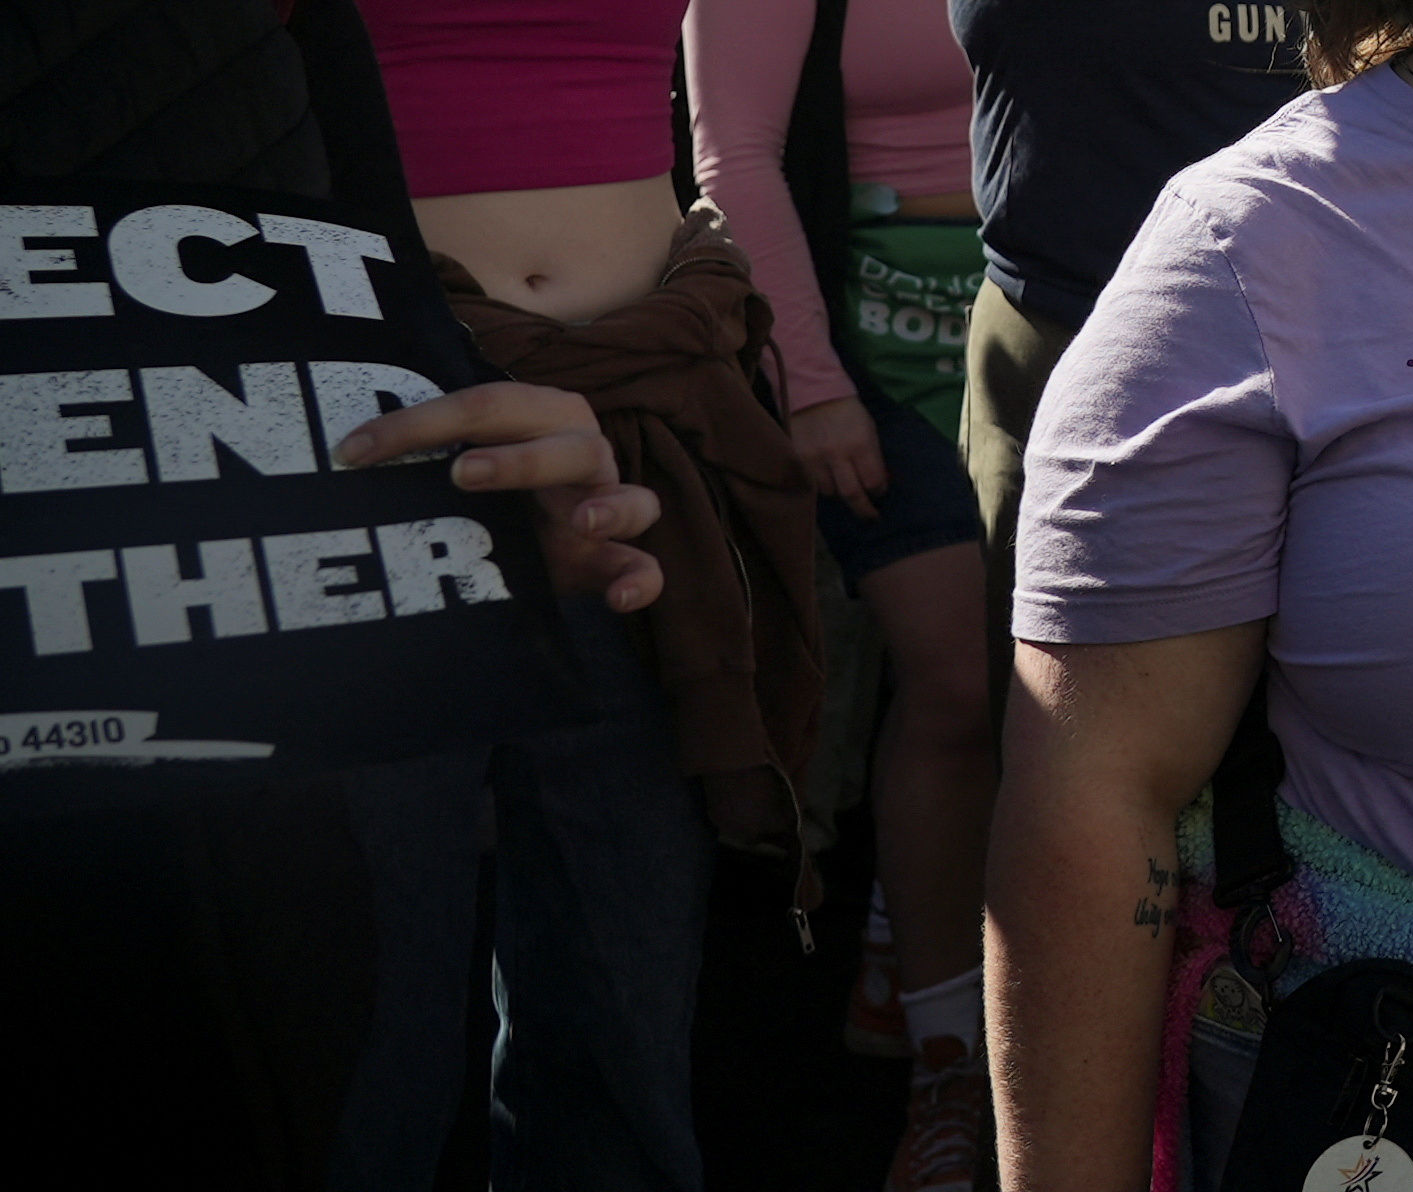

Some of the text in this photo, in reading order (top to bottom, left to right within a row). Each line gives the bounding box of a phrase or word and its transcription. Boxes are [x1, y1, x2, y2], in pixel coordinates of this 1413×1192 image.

[1209, 3, 1287, 44] GUN
[0, 204, 396, 322] ECT
[0, 360, 464, 495] END
[0, 514, 514, 658] THER
[22, 716, 127, 753] 44310
